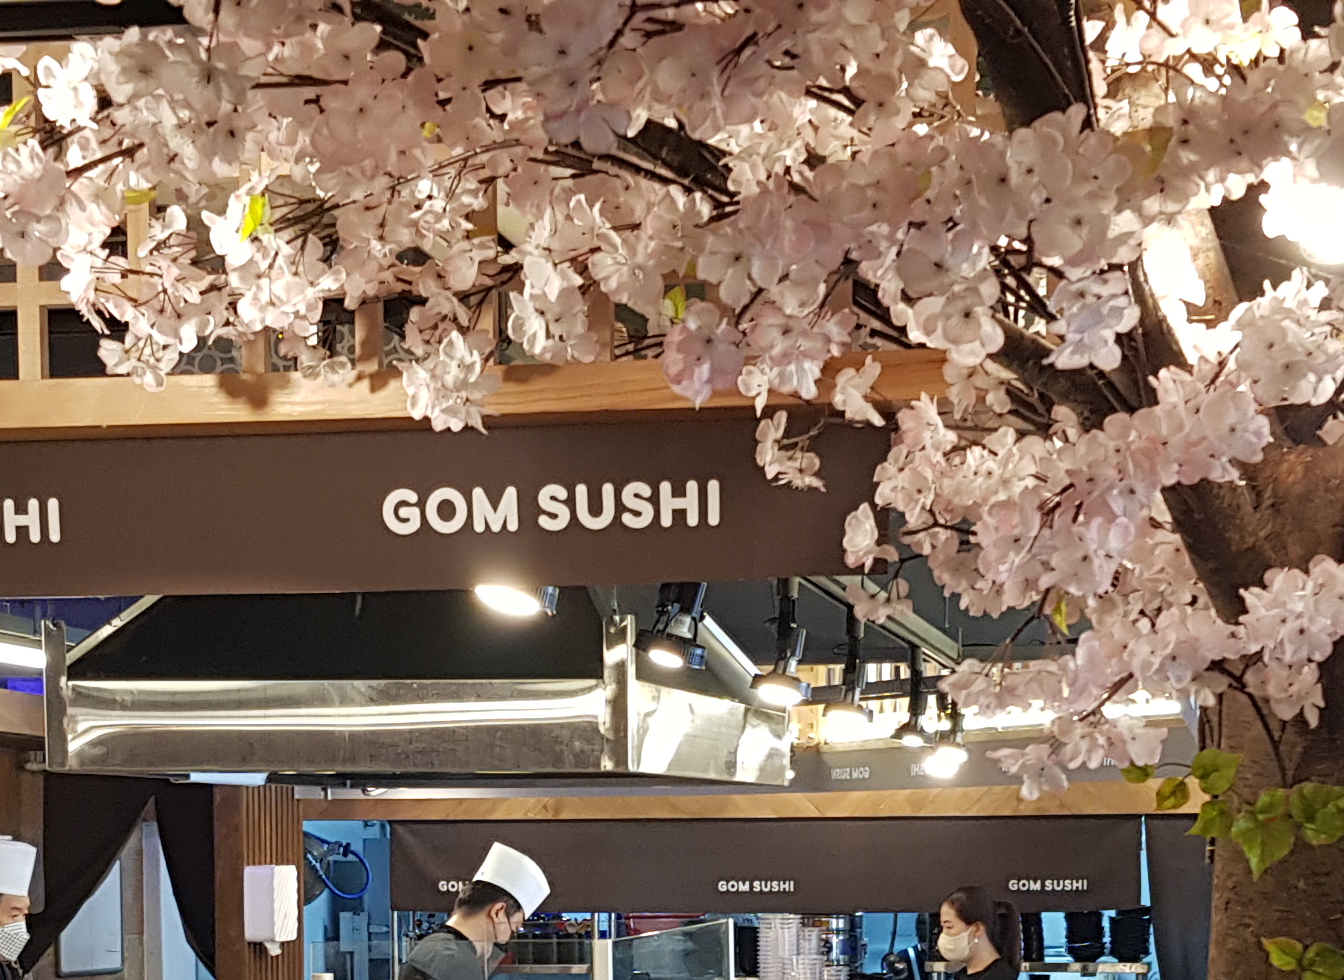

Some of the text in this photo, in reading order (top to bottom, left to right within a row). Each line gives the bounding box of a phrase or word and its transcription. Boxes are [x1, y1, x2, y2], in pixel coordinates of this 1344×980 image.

[382, 479, 721, 535] GOM SUSHI
[717, 880, 795, 892] GOM SUSHI
[1008, 879, 1088, 891] GOM SUSHI
